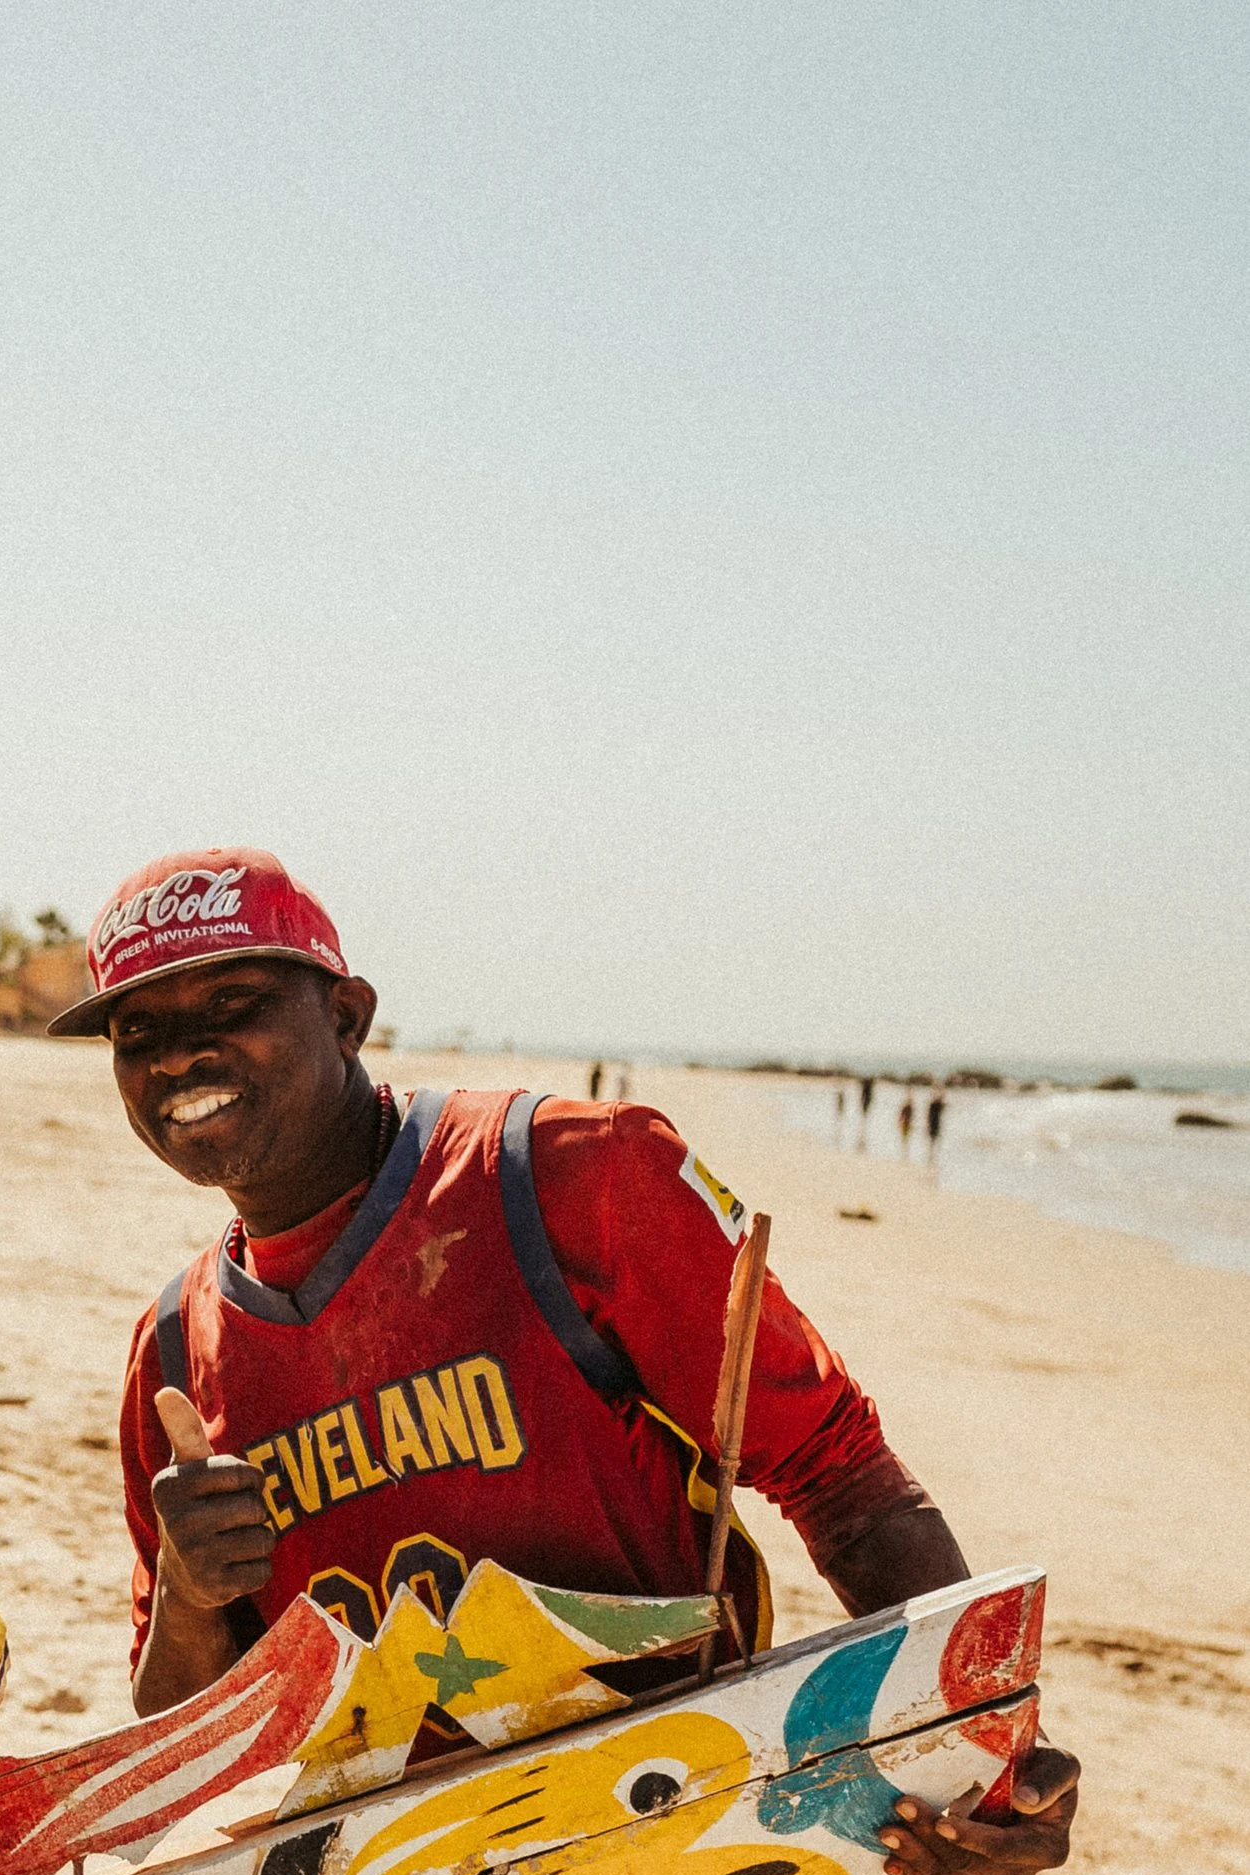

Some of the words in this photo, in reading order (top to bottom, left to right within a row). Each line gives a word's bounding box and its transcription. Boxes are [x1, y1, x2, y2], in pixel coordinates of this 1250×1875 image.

[114, 938, 150, 965] GREEN
[154, 921, 253, 945] INVITATIONAL
[244, 1353, 527, 1536] EVELAND
